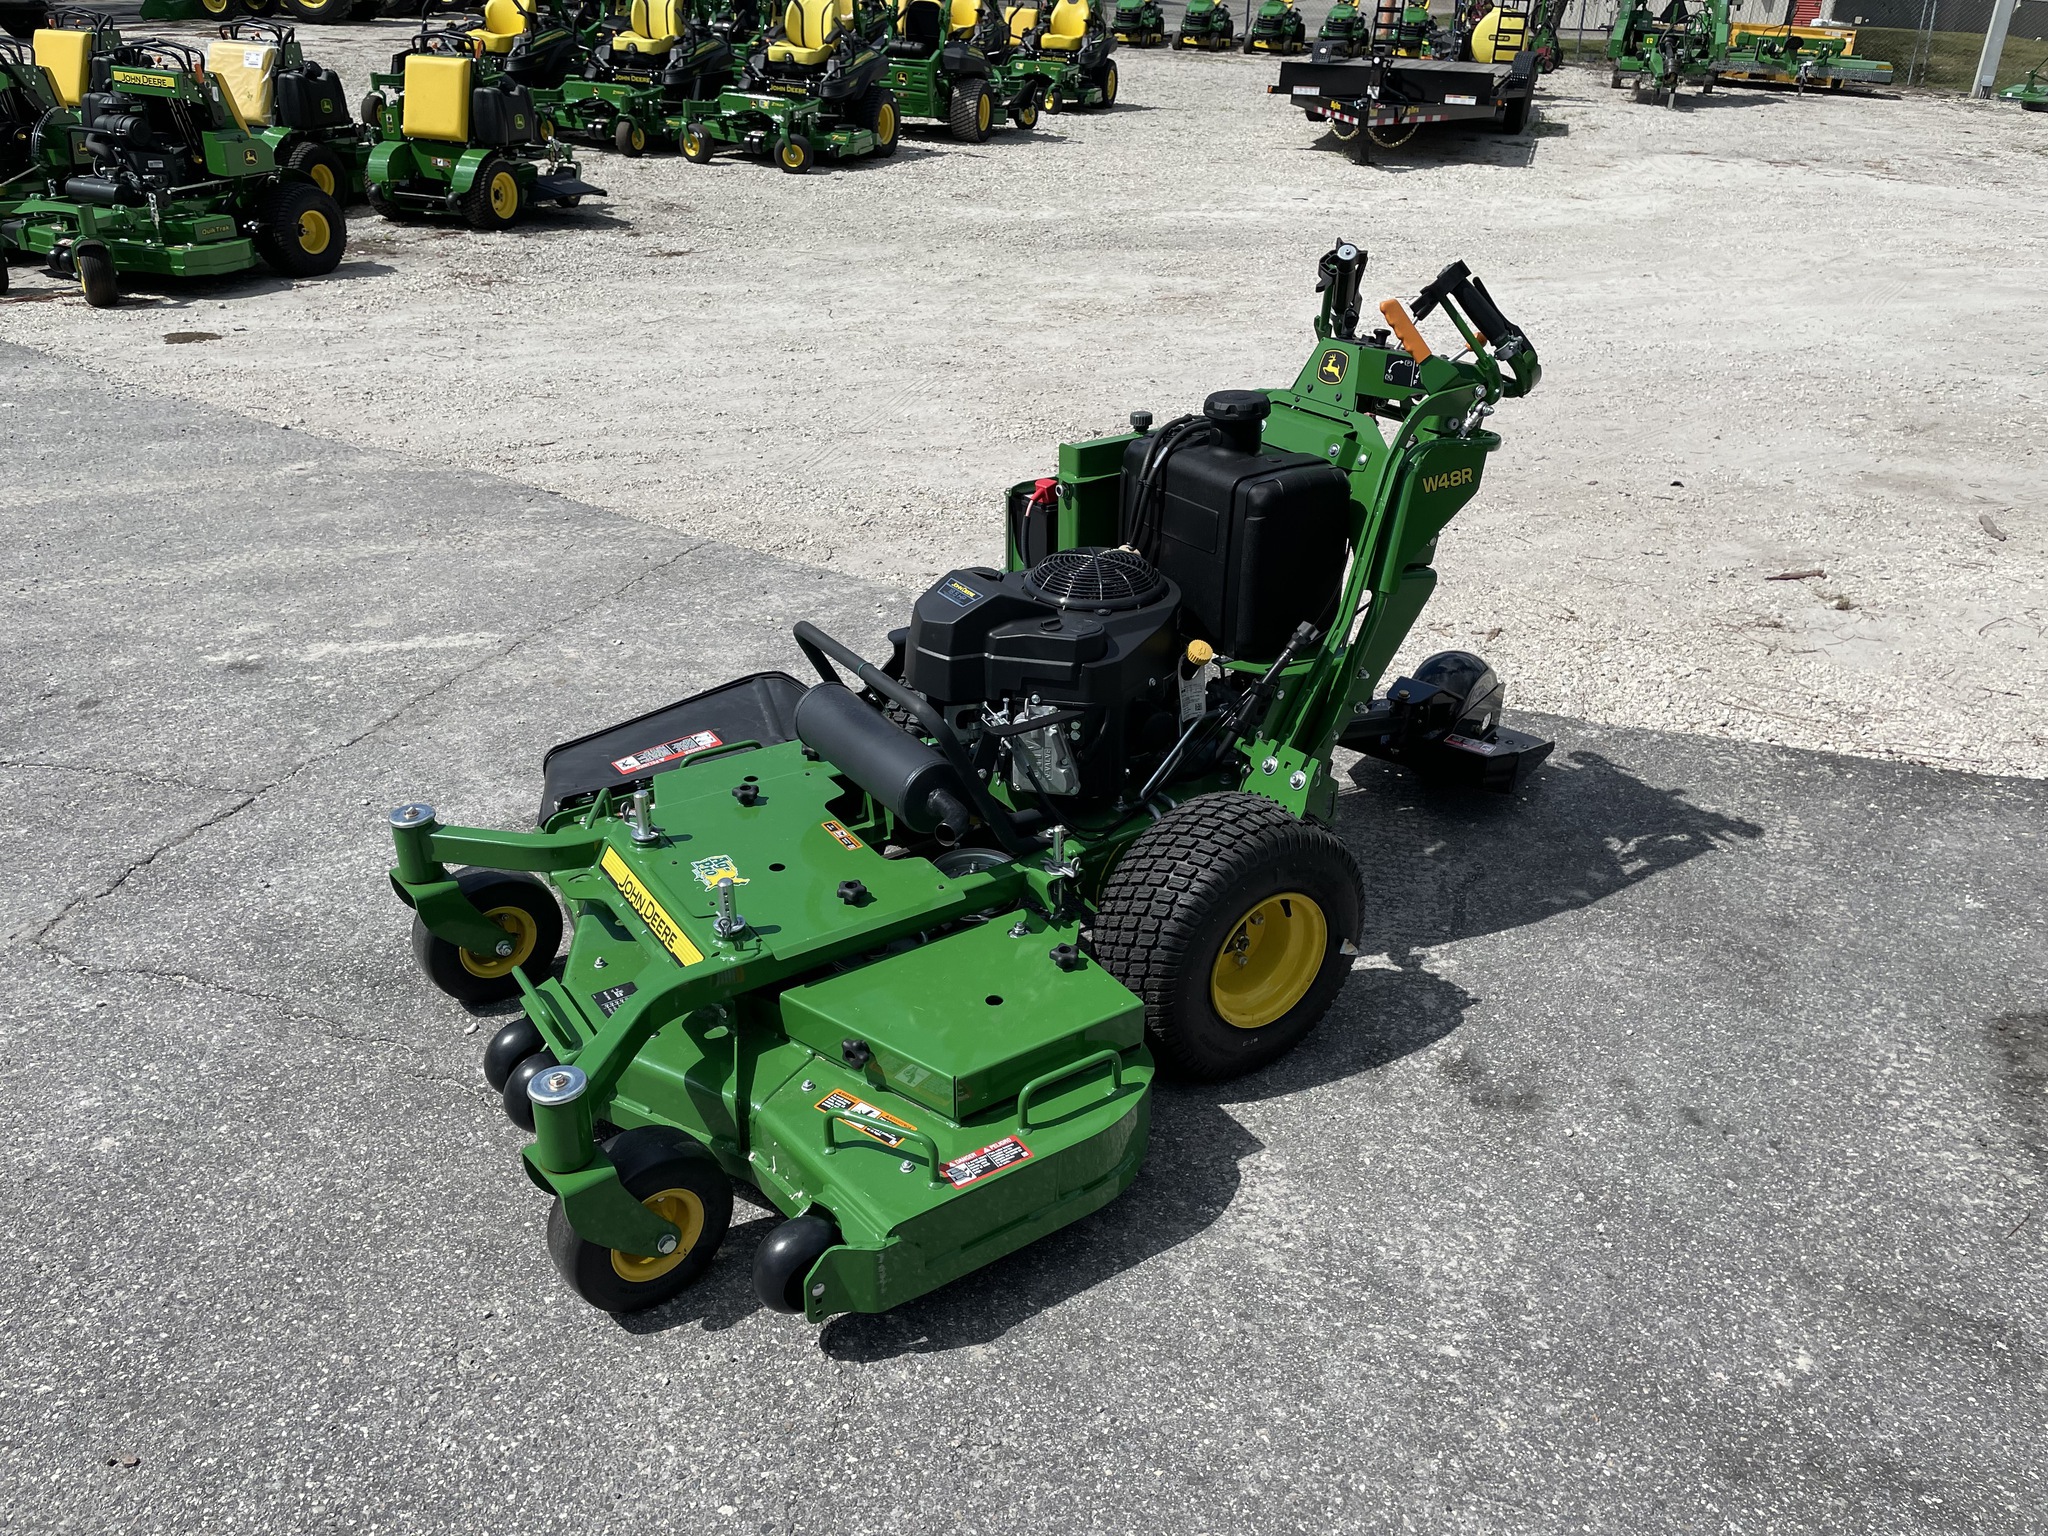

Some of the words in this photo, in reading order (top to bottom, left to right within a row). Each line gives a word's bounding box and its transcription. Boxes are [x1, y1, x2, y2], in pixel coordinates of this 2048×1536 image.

[122, 73, 141, 84] JOHN
[141, 74, 167, 87] DEERE
[630, 75, 651, 84] DEERE
[769, 84, 786, 92] JOHN
[786, 85, 808, 95] DEERE
[1422, 467, 1474, 494] W48R
[952, 582, 963, 590] JOHN
[618, 874, 646, 911] JOHN
[643, 901, 678, 950] DEERE
[988, 1137, 1012, 1151] PELIGRO
[954, 1152, 977, 1165] DANGER
